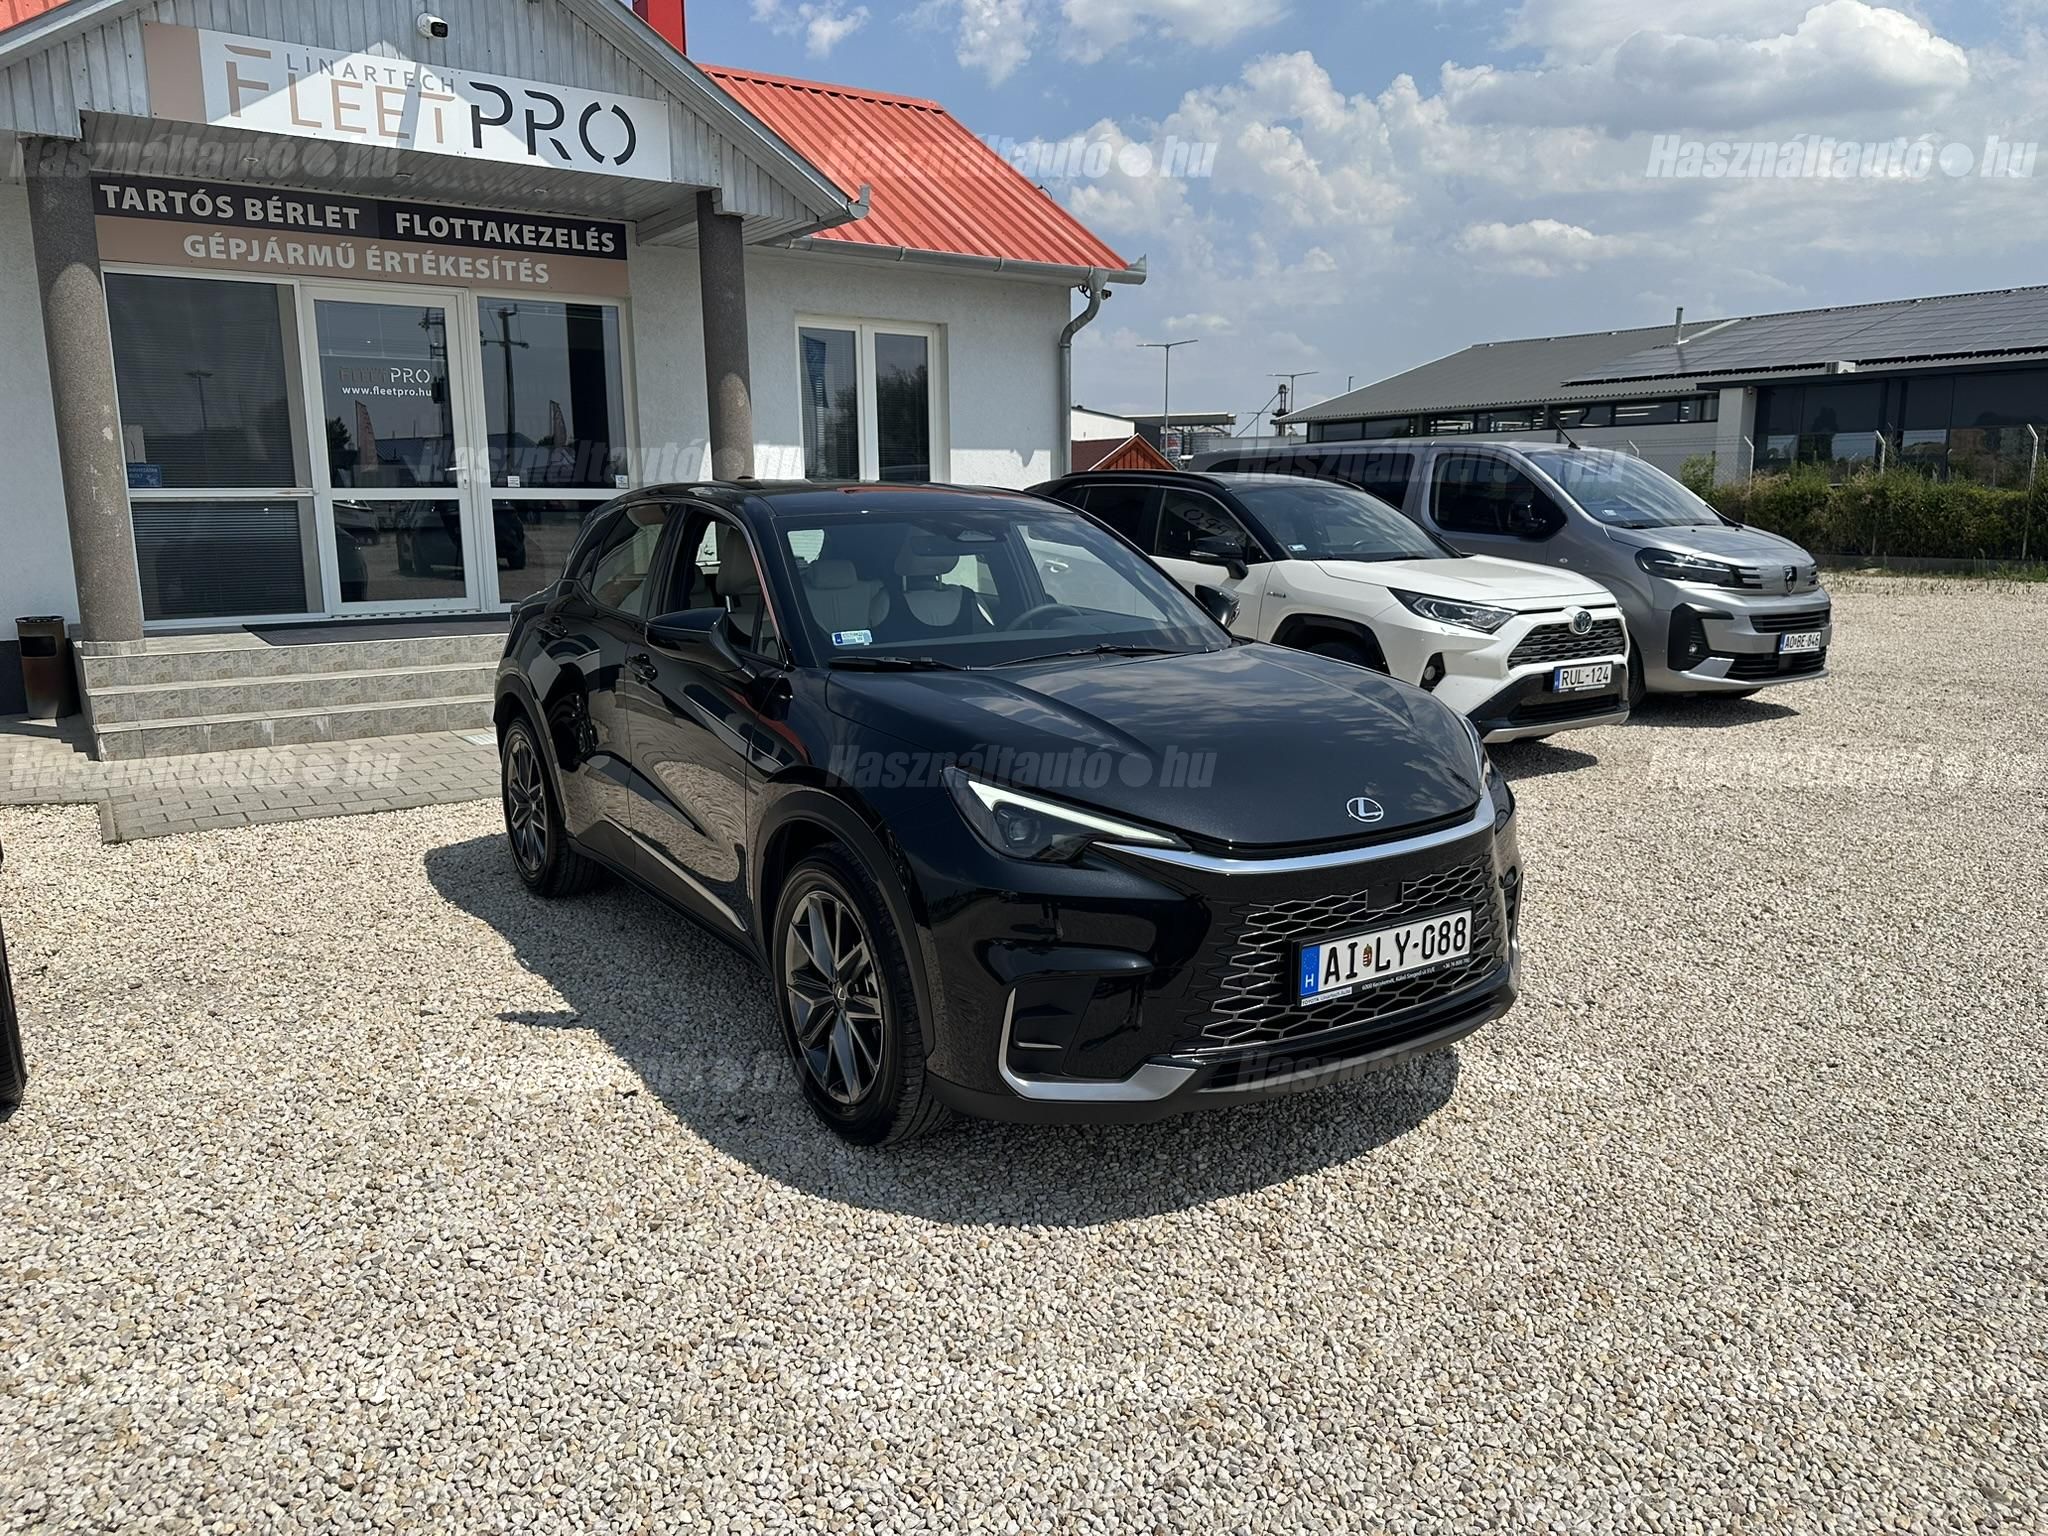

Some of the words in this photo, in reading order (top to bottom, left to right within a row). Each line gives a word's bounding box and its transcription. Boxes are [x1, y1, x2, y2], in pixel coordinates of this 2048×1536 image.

[287, 52, 456, 95] LINARTECH
[101, 183, 236, 220] TARTÓS
[244, 197, 361, 231] BÉRLET
[395, 211, 617, 255] FLOTTAKEZELÉS
[182, 233, 358, 271] GÉPJÁRMŰ
[365, 244, 550, 285] ÉRTÉKESÍTÉS
[341, 385, 432, 398] www.fleetpro.hu
[1562, 666, 1609, 687] RUL-124
